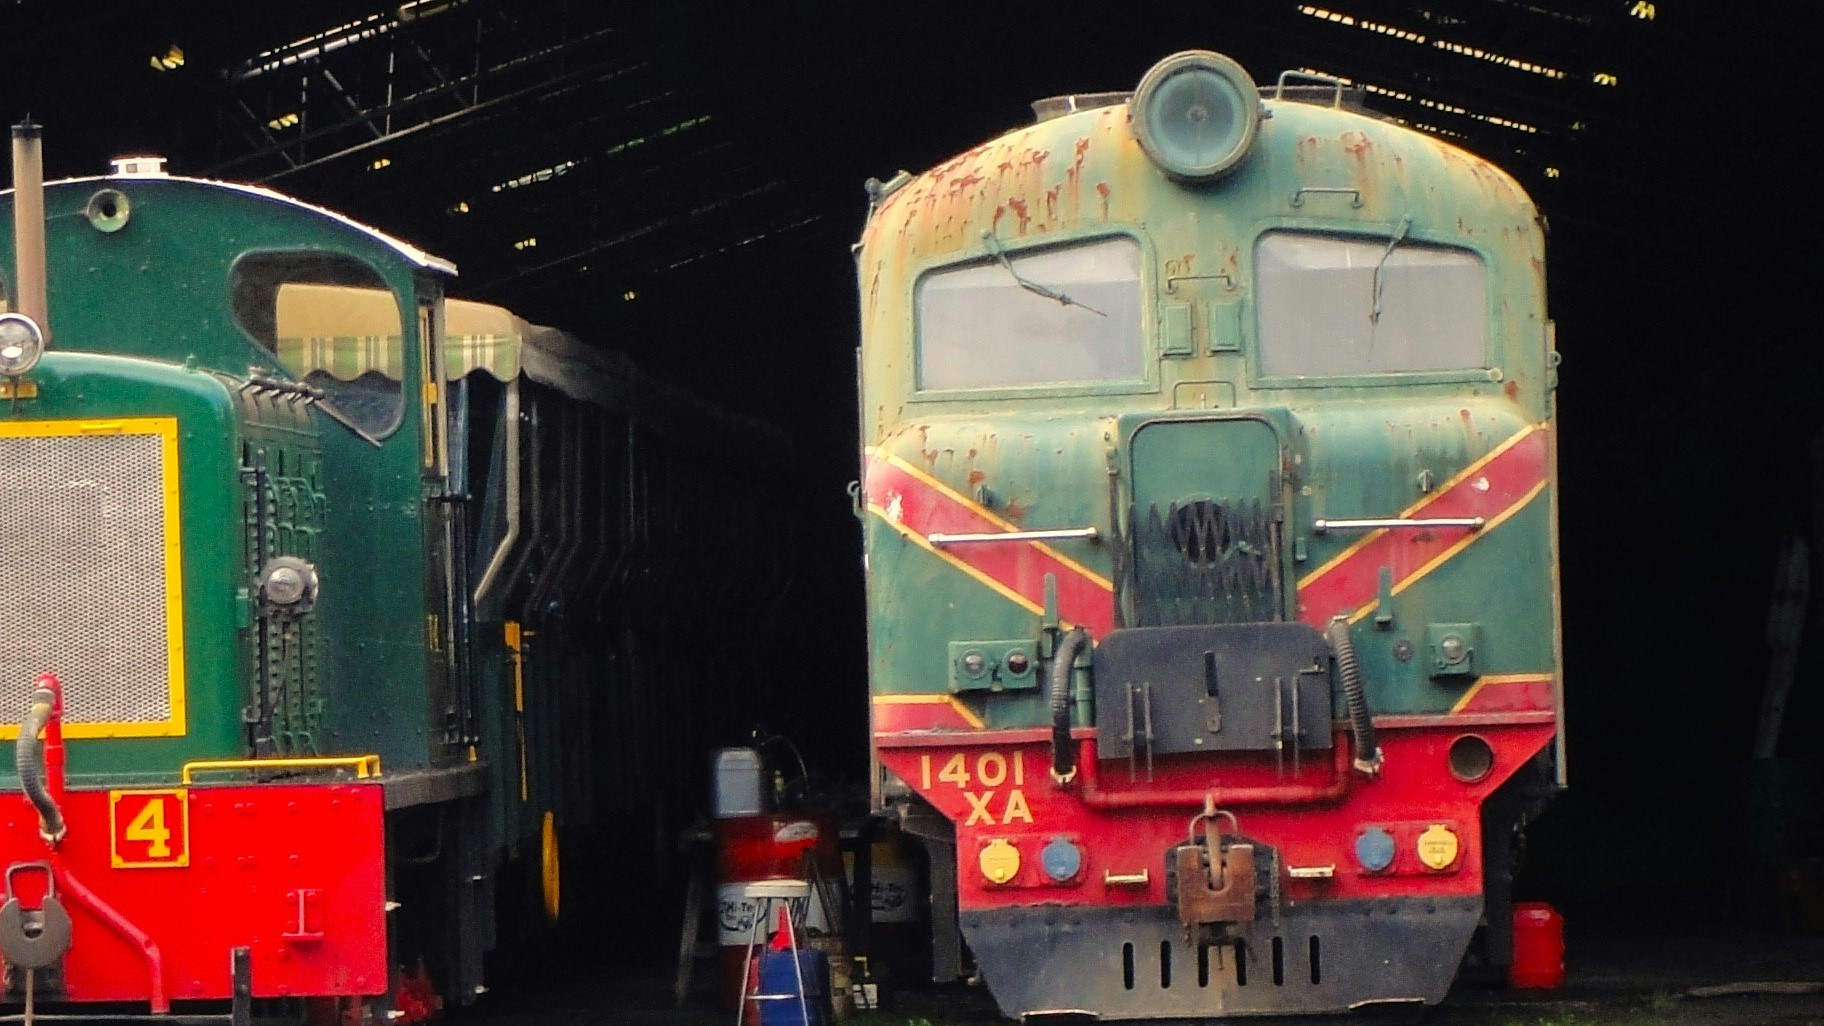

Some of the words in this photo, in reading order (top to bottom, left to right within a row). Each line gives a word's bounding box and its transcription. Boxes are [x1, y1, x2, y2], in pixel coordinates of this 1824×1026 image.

[921, 752, 1025, 791] 1401
[964, 789, 1033, 827] XA
[126, 798, 171, 858] 4
